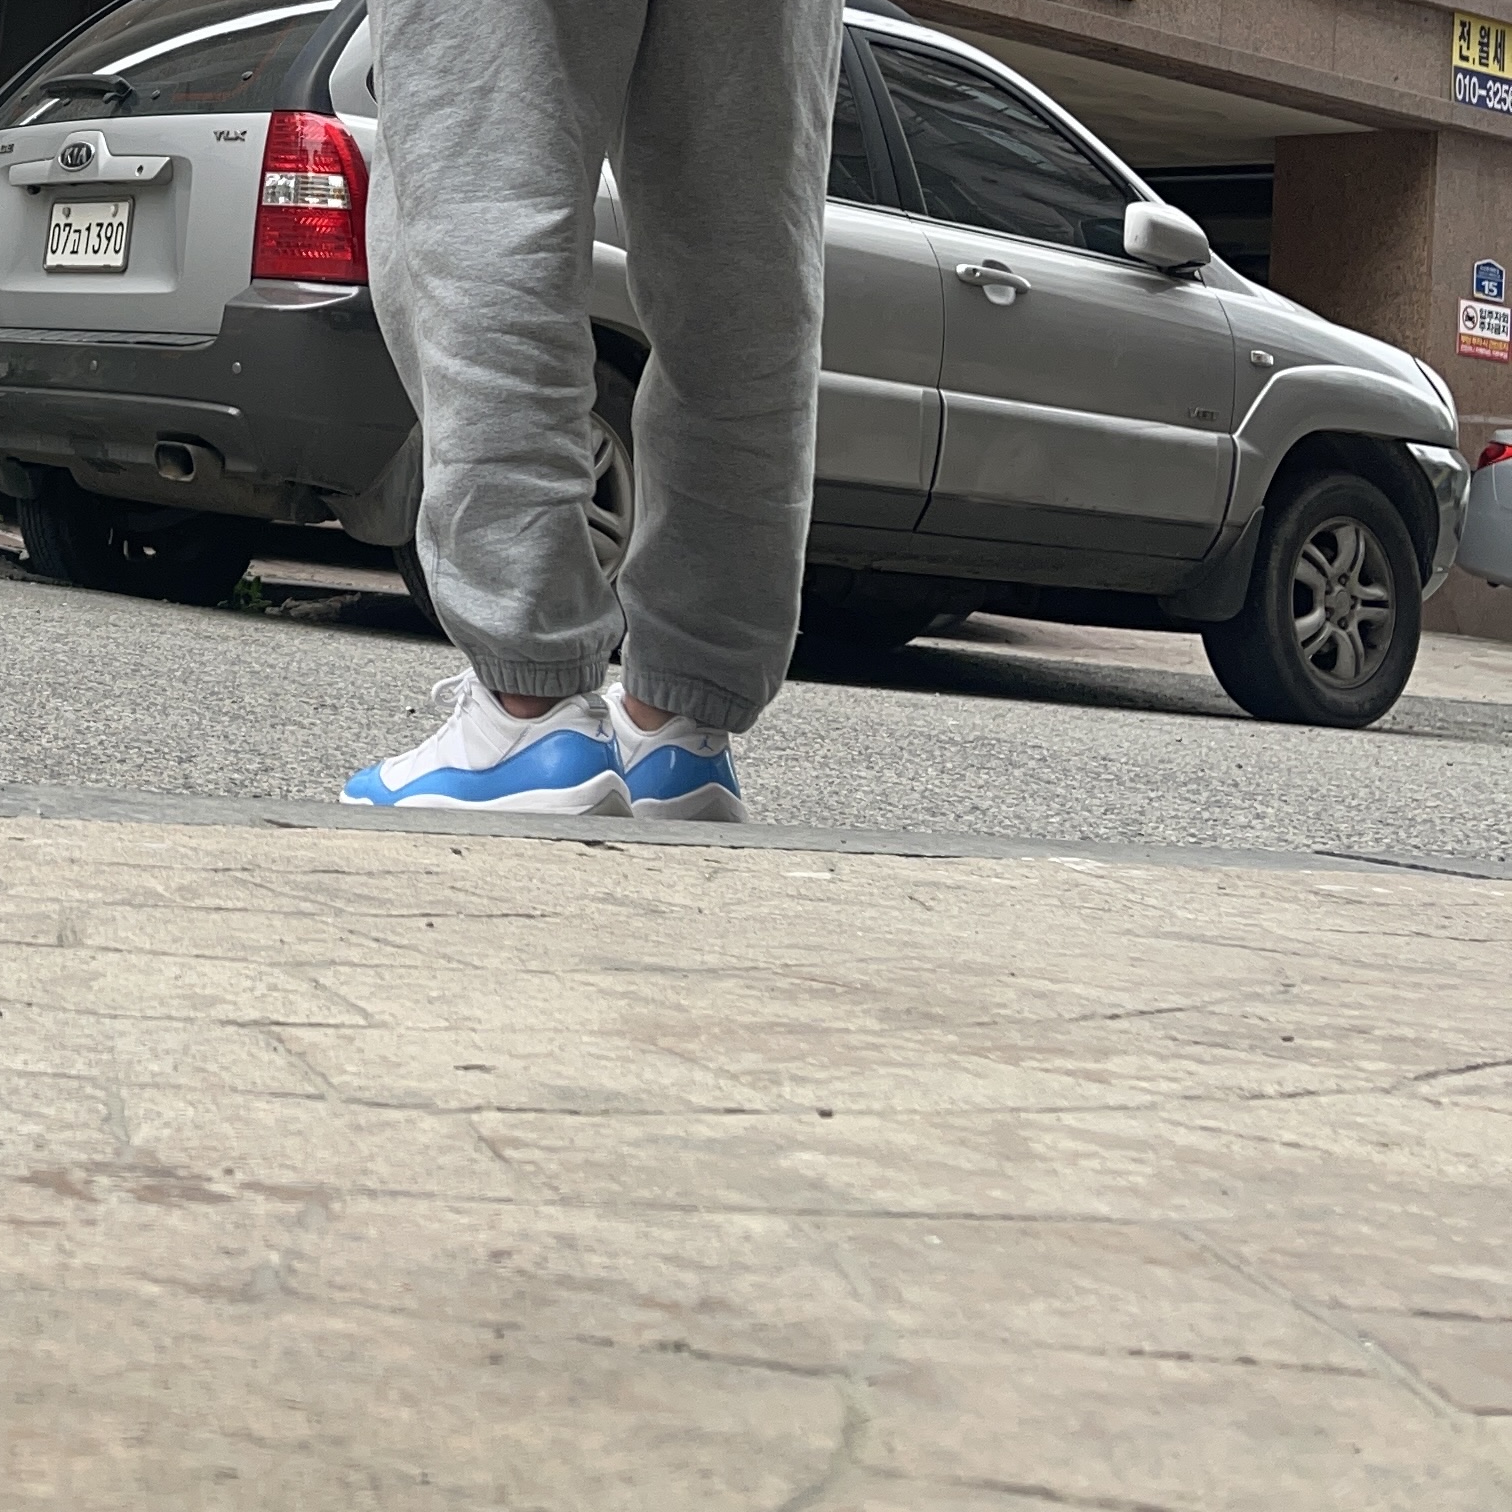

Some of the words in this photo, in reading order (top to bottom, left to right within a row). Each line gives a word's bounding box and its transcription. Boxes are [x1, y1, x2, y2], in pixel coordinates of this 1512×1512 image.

[62, 144, 88, 165] KIA
[49, 220, 126, 256] 07고1390
[1481, 279, 1498, 297] 15
